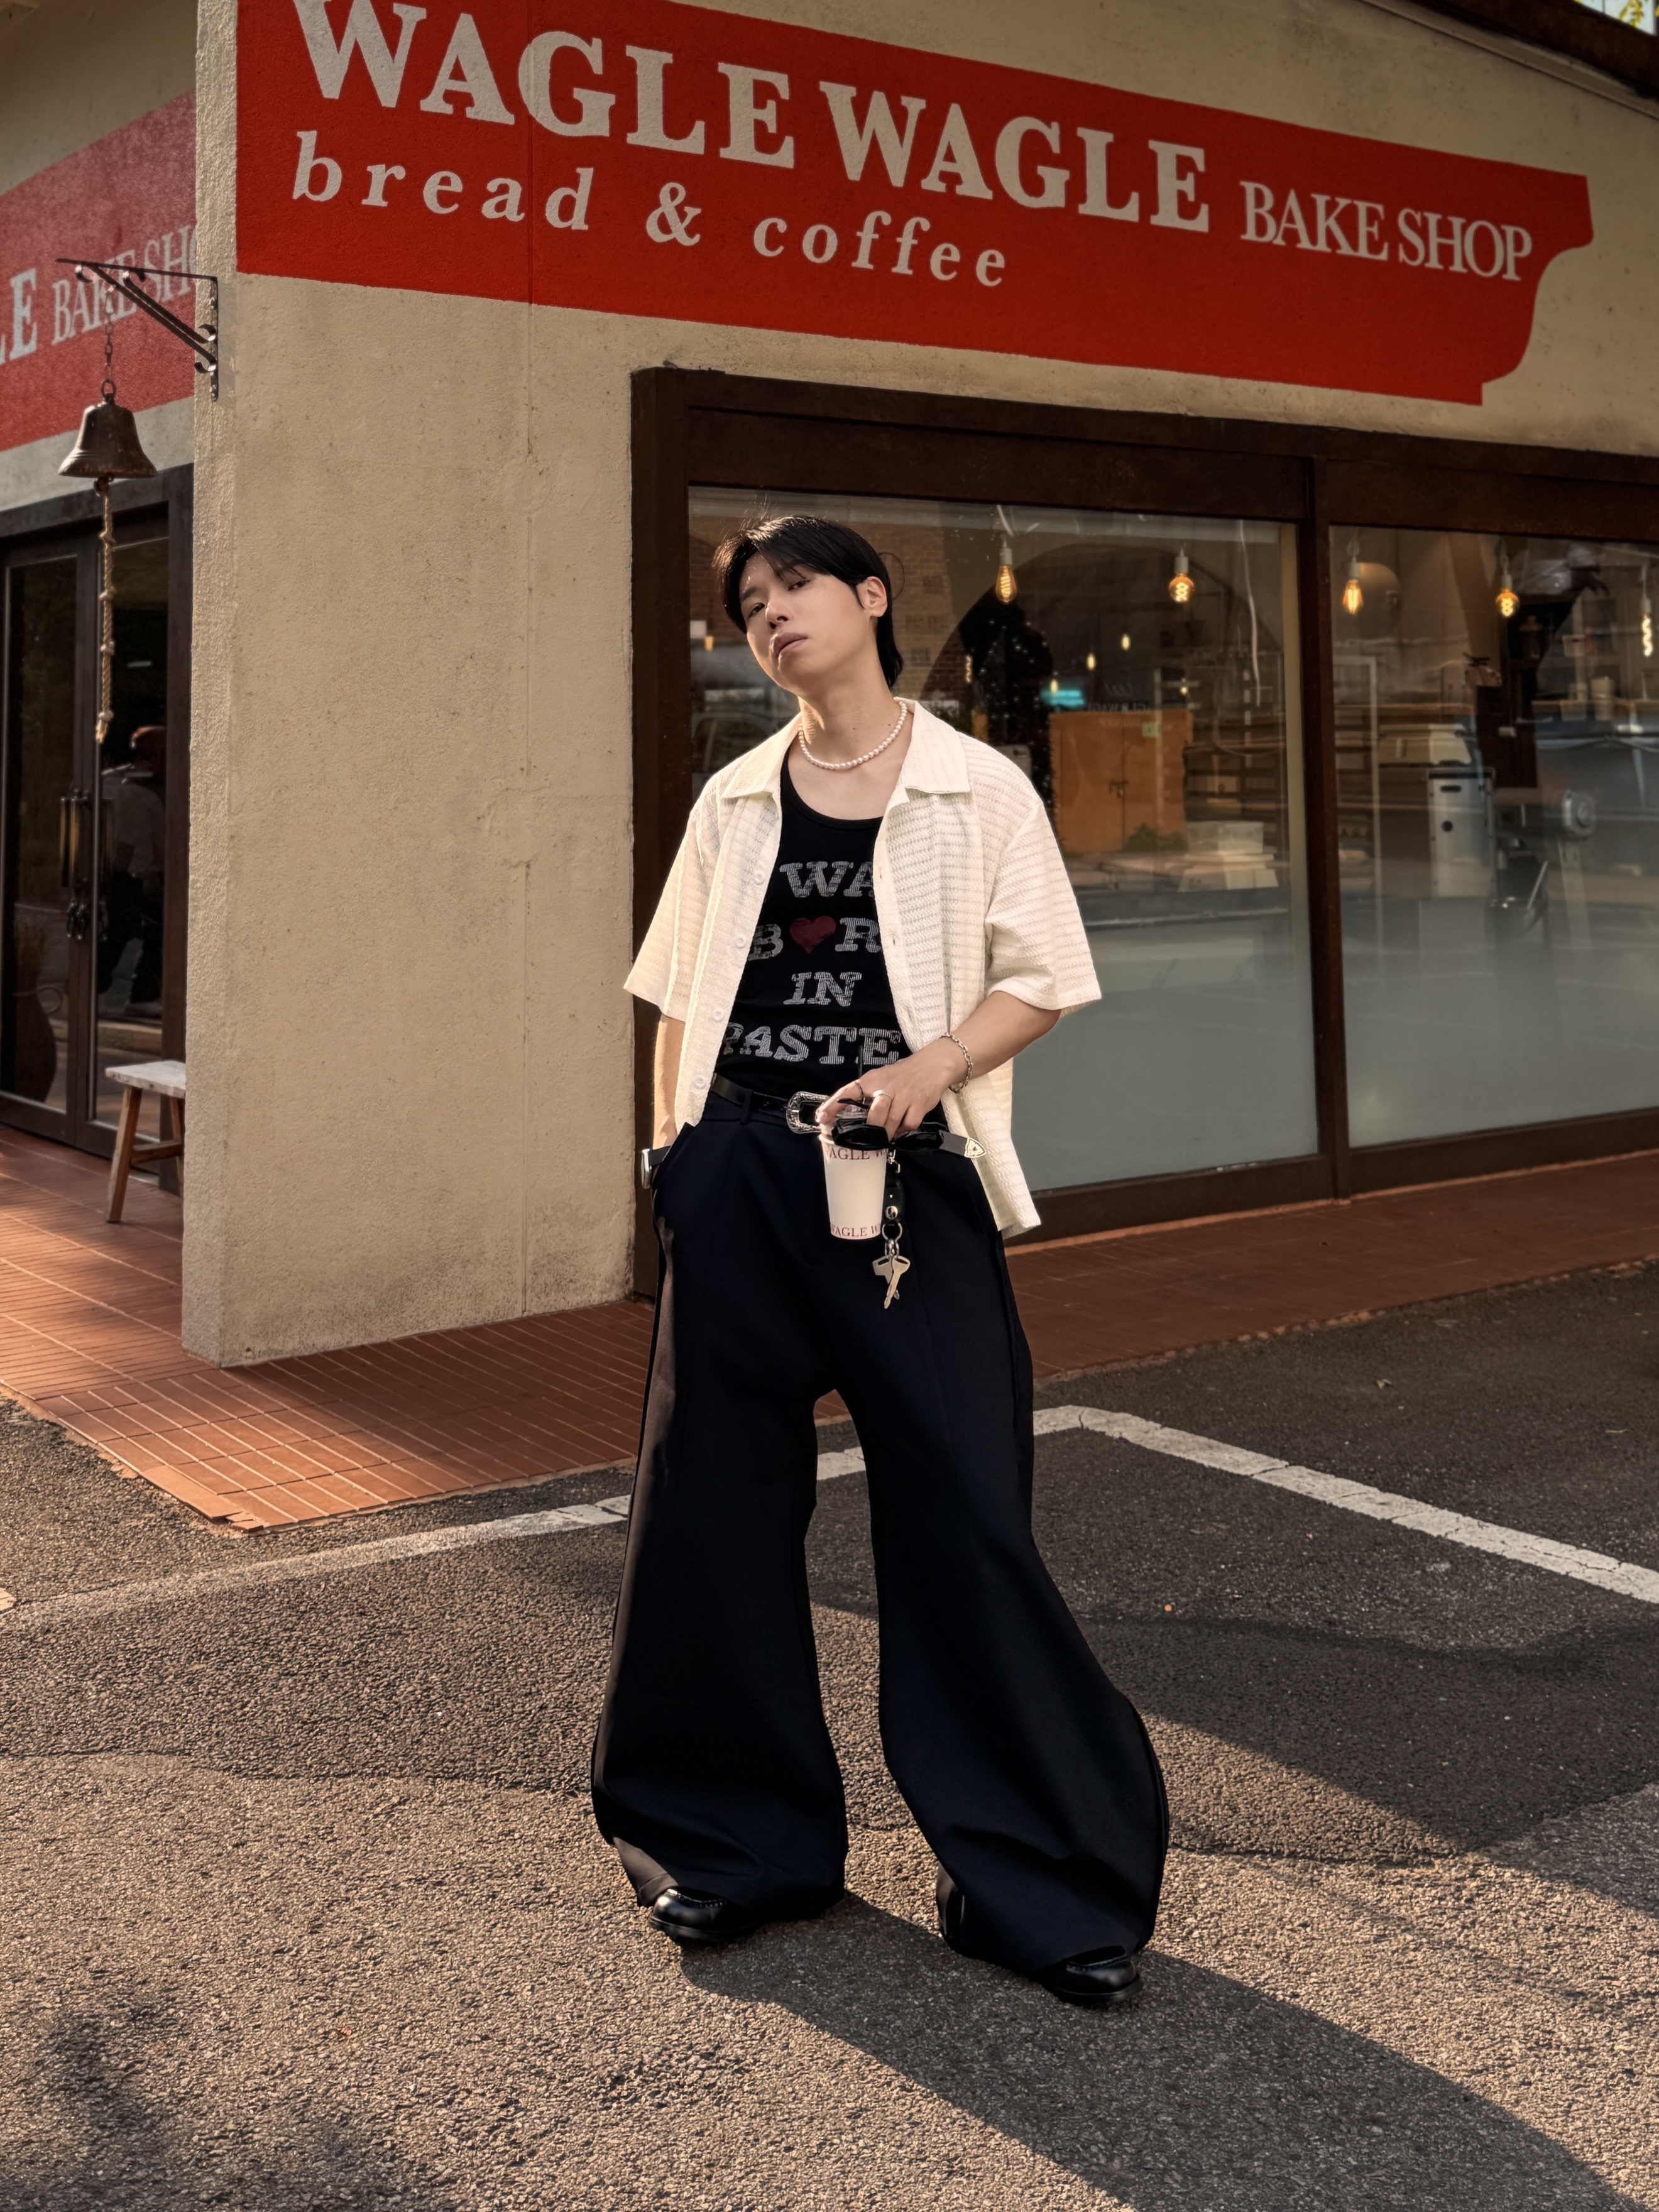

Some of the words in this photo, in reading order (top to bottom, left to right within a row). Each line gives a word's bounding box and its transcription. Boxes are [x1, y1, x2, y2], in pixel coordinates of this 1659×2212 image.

[293, 0, 794, 168] WAGLE
[820, 82, 1208, 232] WAGLE
[1241, 182, 1388, 260] BAKE
[1398, 209, 1531, 280] SHOP
[293, 131, 593, 230] bread
[646, 182, 701, 246] &
[754, 211, 1004, 286] coffee
[0, 268, 37, 366] E
[783, 972, 862, 1007] IN
[826, 1145, 870, 1160] AGLE
